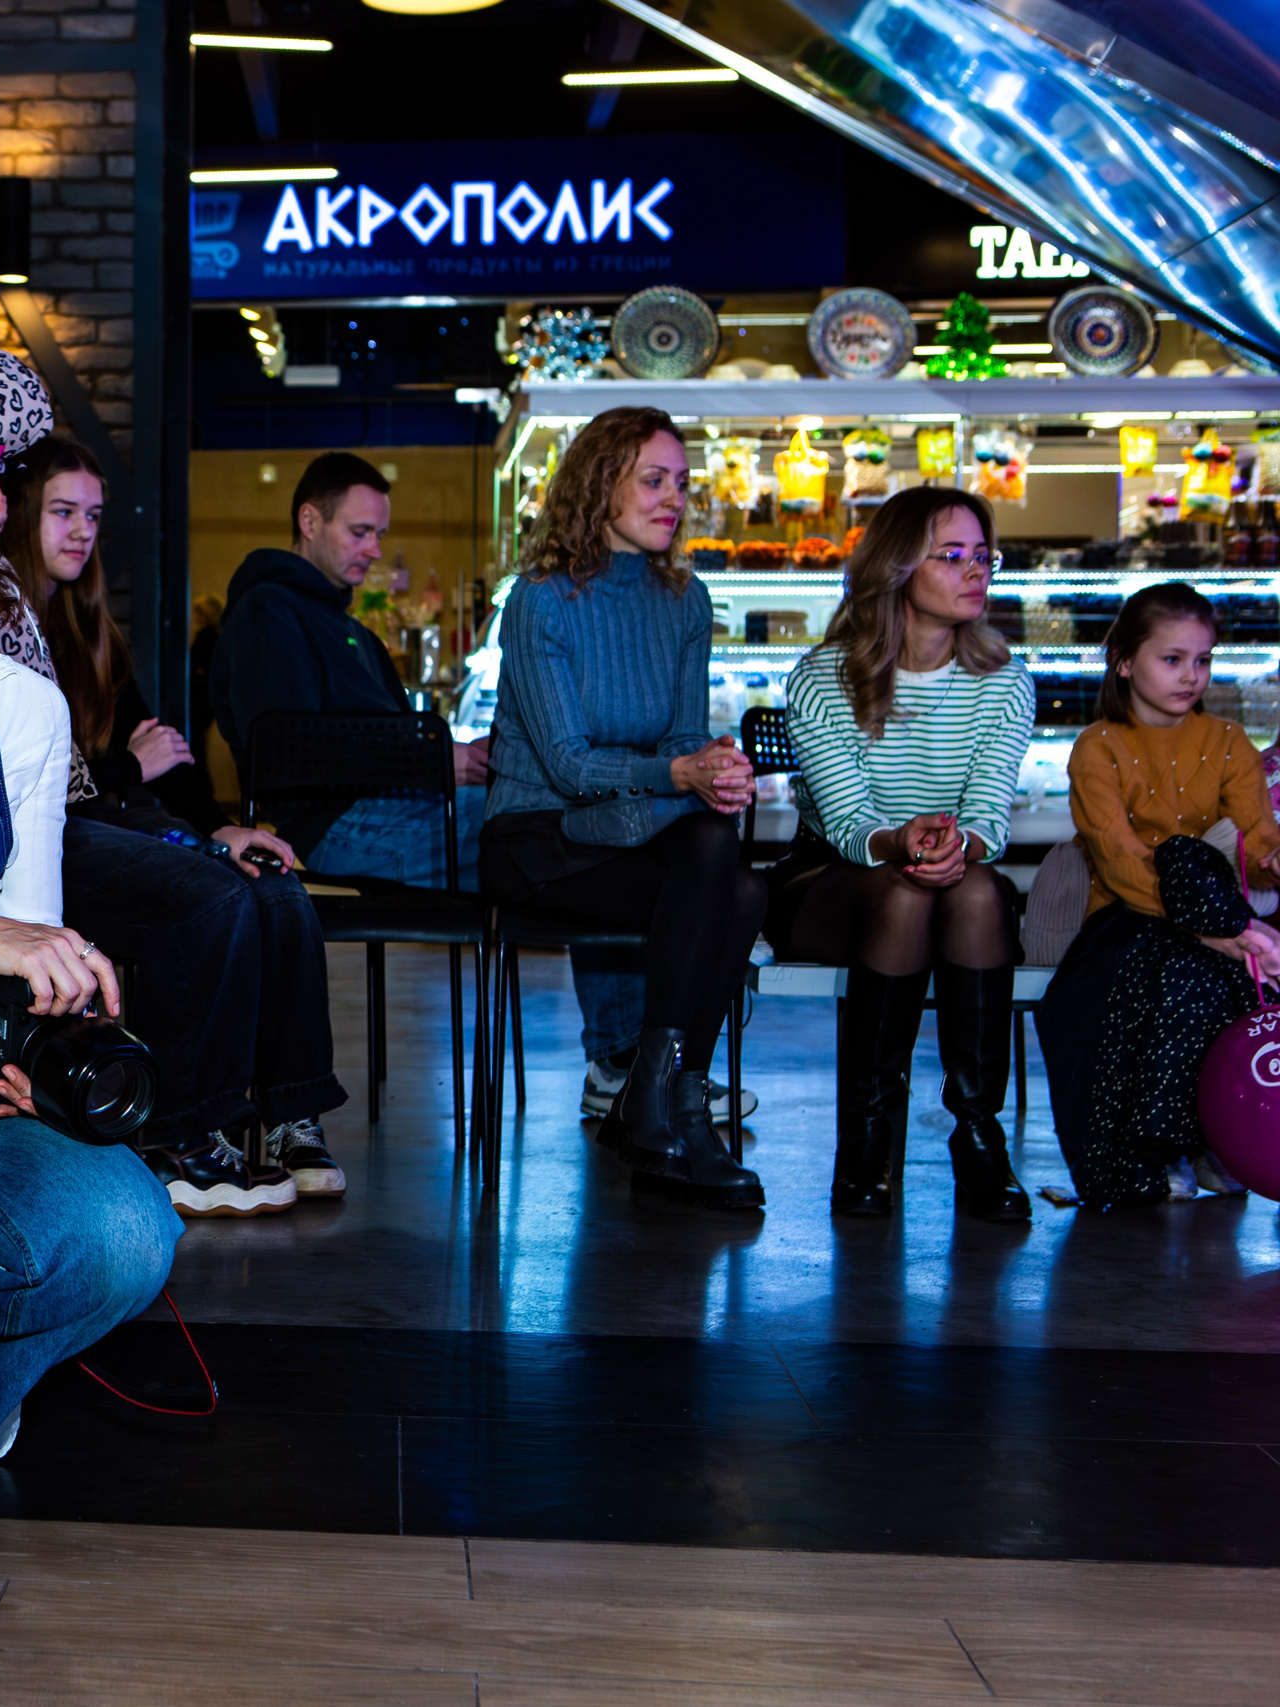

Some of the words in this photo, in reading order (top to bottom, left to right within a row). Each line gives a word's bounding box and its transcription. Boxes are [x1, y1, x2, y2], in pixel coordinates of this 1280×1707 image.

[262, 178, 674, 254] АКРОПОЛИС
[263, 258, 417, 279] НАТУРАЛЬНЫЕ
[427, 256, 543, 278] ПРОДУКТЫ
